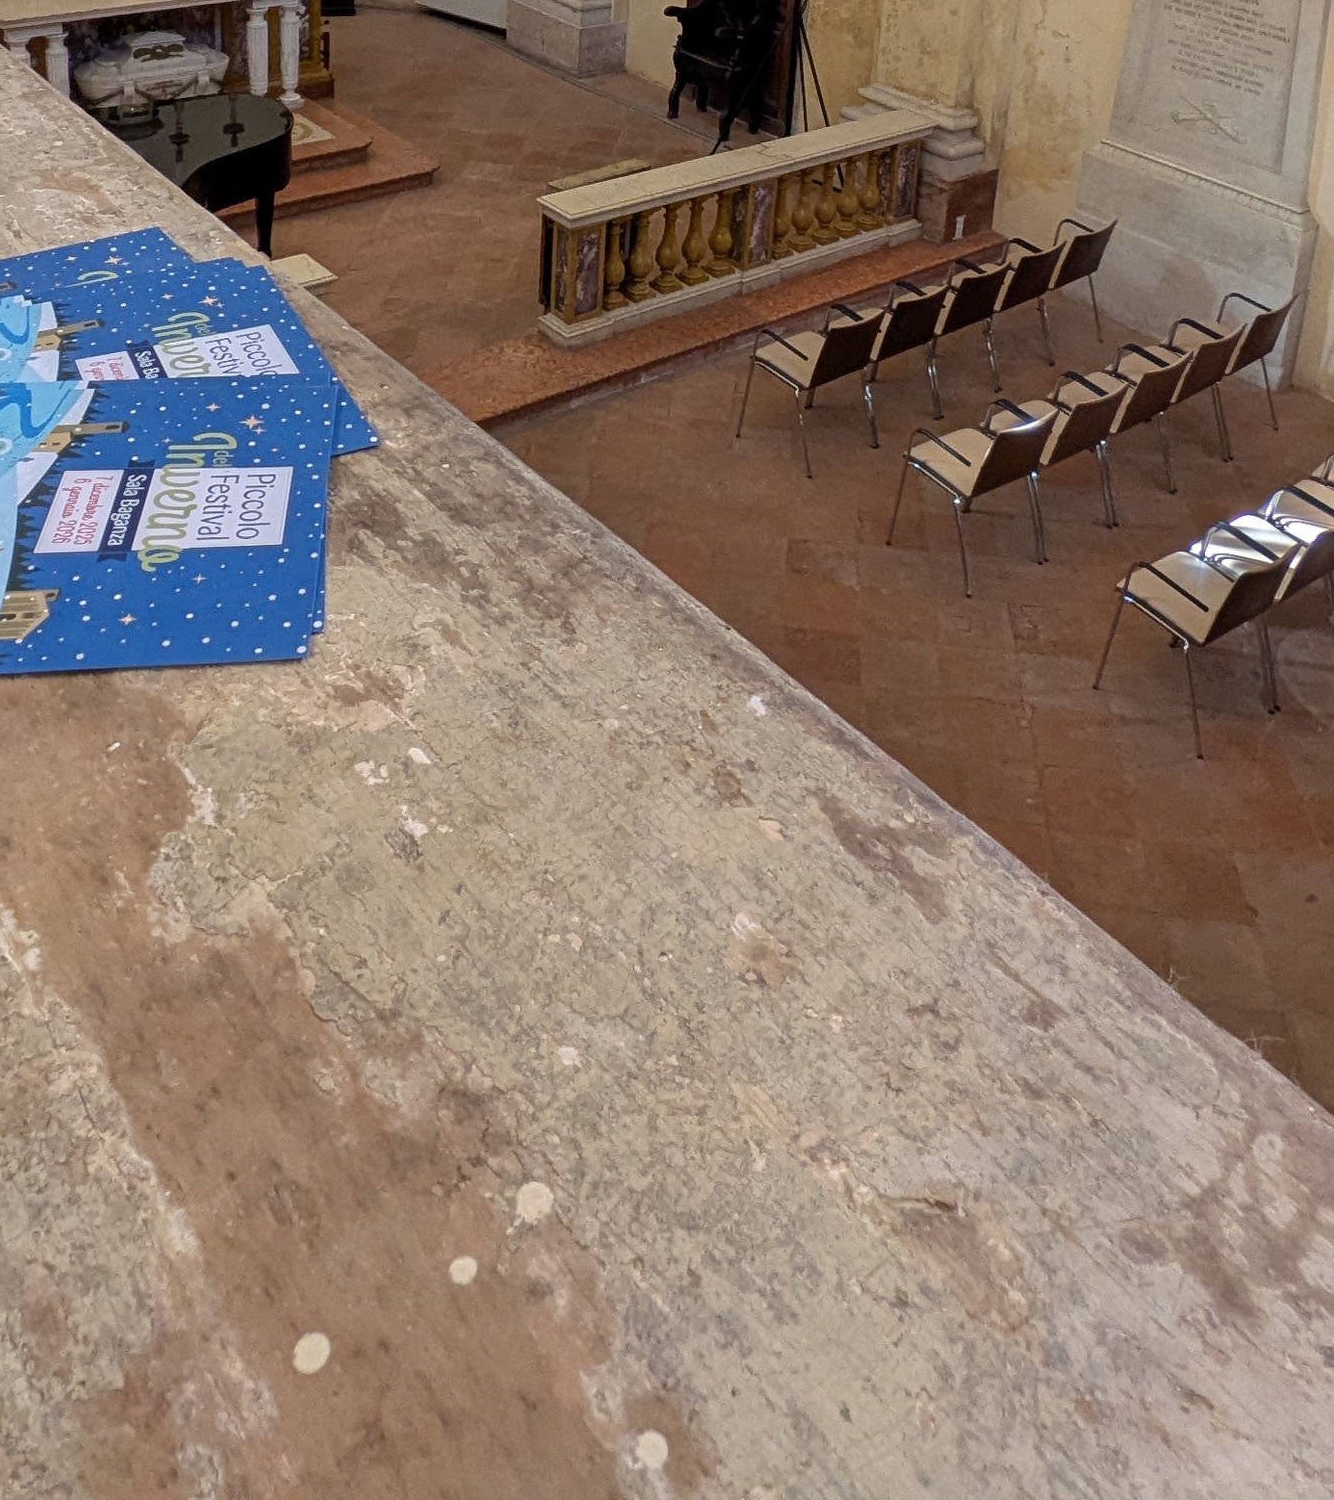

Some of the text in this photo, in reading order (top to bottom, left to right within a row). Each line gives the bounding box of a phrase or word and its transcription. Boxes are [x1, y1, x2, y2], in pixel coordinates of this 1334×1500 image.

[152, 311, 211, 378] Inver
[205, 337, 245, 376] Festiv
[212, 449, 234, 468] del
[51, 520, 73, 544] 2026
[62, 486, 81, 519] gennaio
[73, 475, 114, 546] 7 dicembre 2025
[106, 473, 147, 547] Sala Baganza
[137, 432, 238, 573] Inverno
[196, 474, 240, 541] Festival
[235, 473, 277, 540] Piccolo
